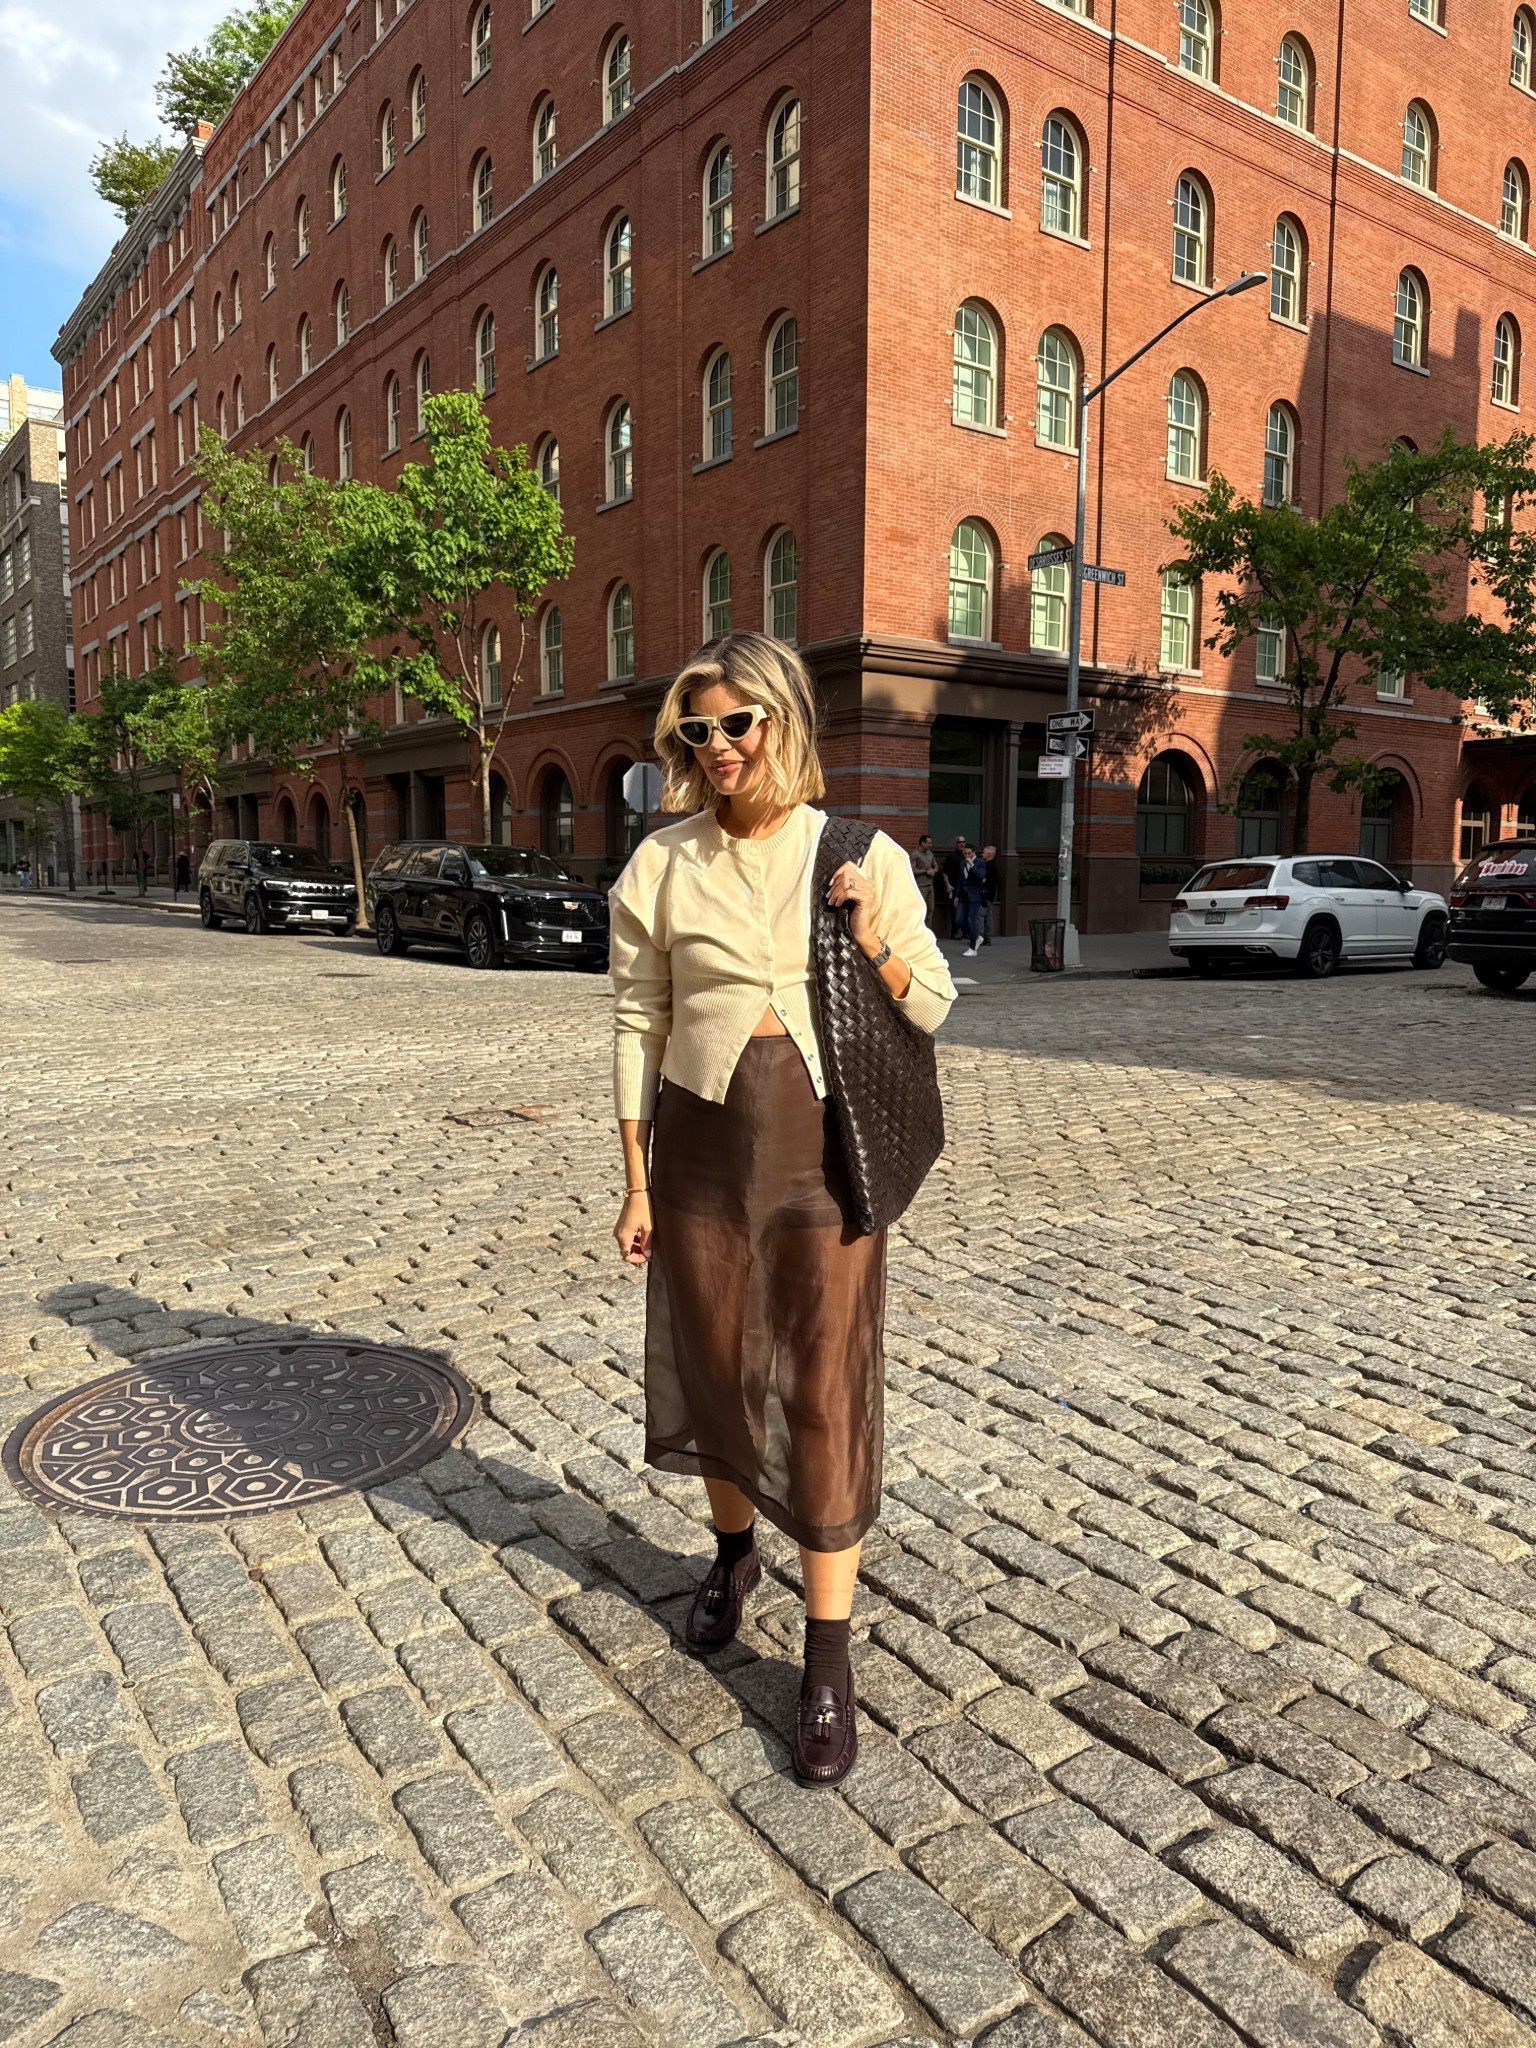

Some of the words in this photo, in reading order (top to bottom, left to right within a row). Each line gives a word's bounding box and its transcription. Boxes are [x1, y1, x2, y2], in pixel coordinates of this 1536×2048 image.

[1029, 550, 1064, 570] DESBROSSES
[1065, 549, 1072, 561] ST
[1083, 567, 1116, 584] GREENWICH
[1117, 574, 1124, 585] ST
[1052, 719, 1064, 728] ONE
[1071, 717, 1084, 726] WAY
